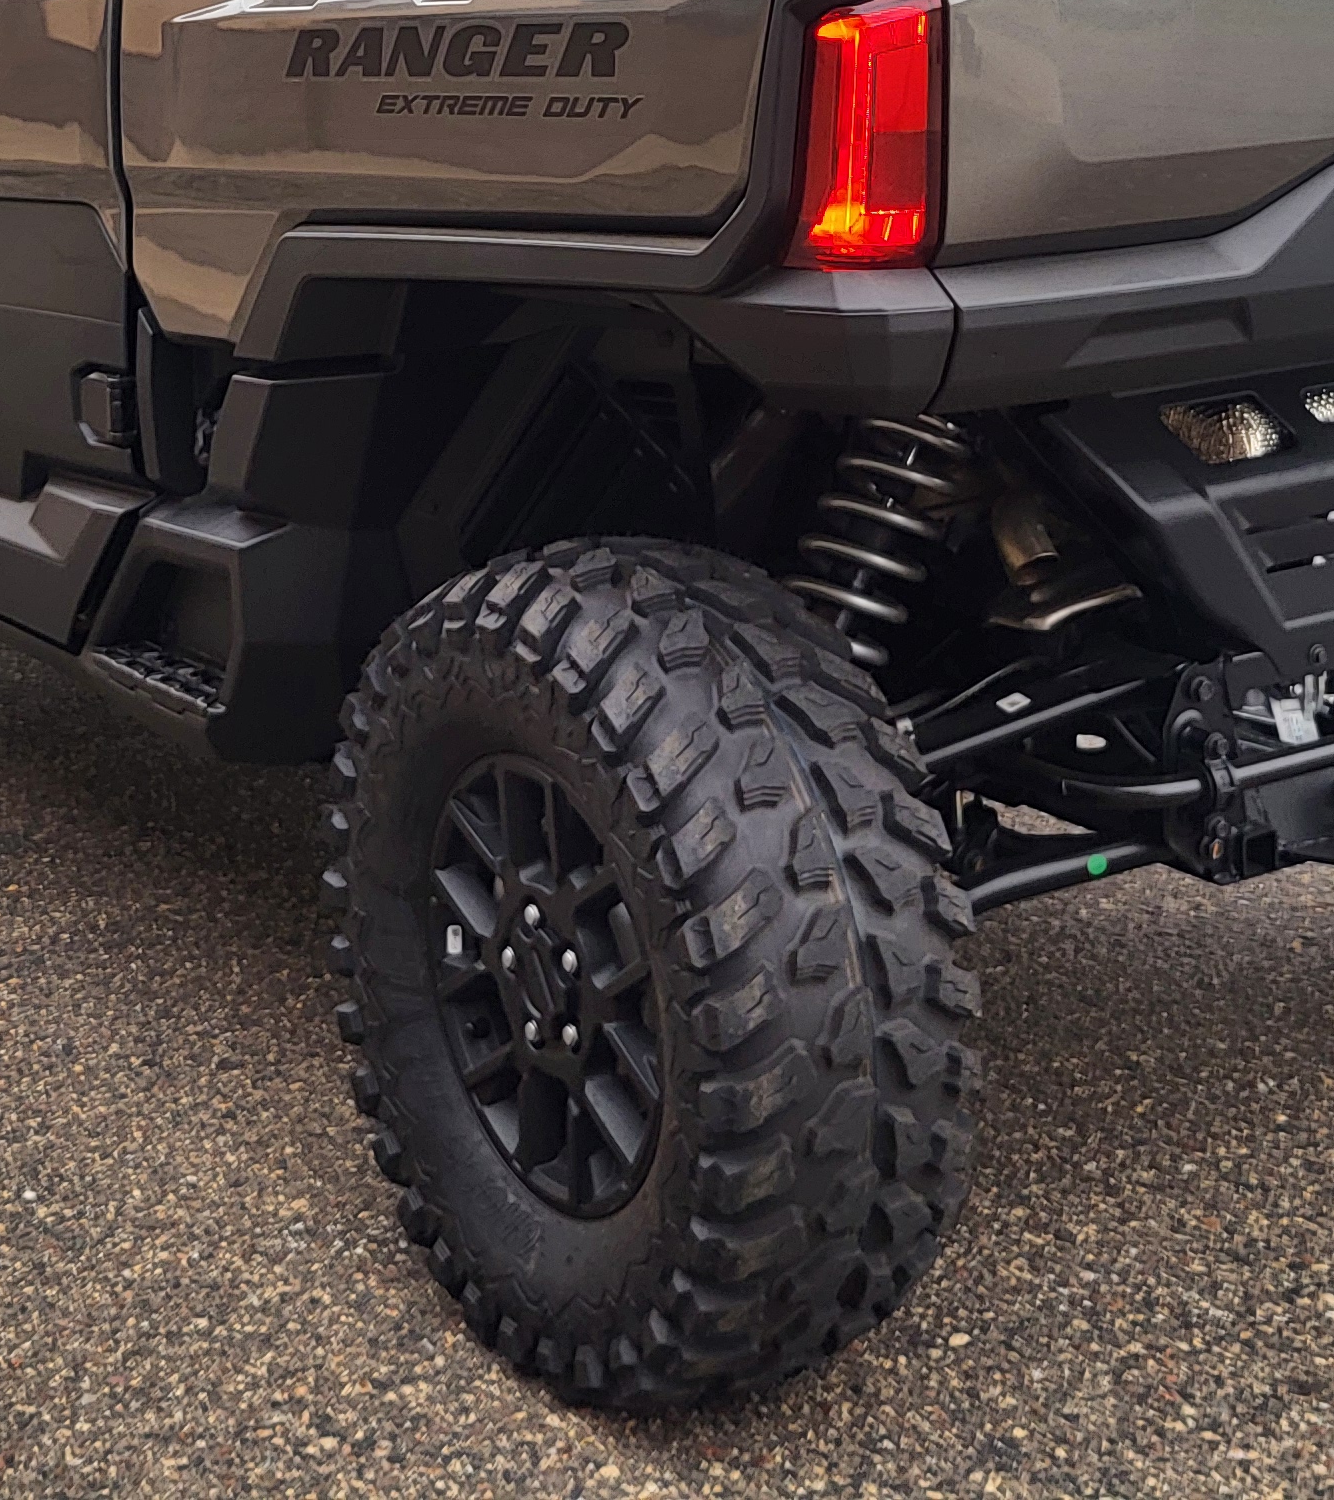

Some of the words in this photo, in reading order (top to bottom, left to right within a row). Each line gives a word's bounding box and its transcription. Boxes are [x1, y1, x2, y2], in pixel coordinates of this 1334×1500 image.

[284, 20, 630, 81] RANGER
[375, 93, 531, 118] EXTREME
[541, 95, 644, 120] DUTY
